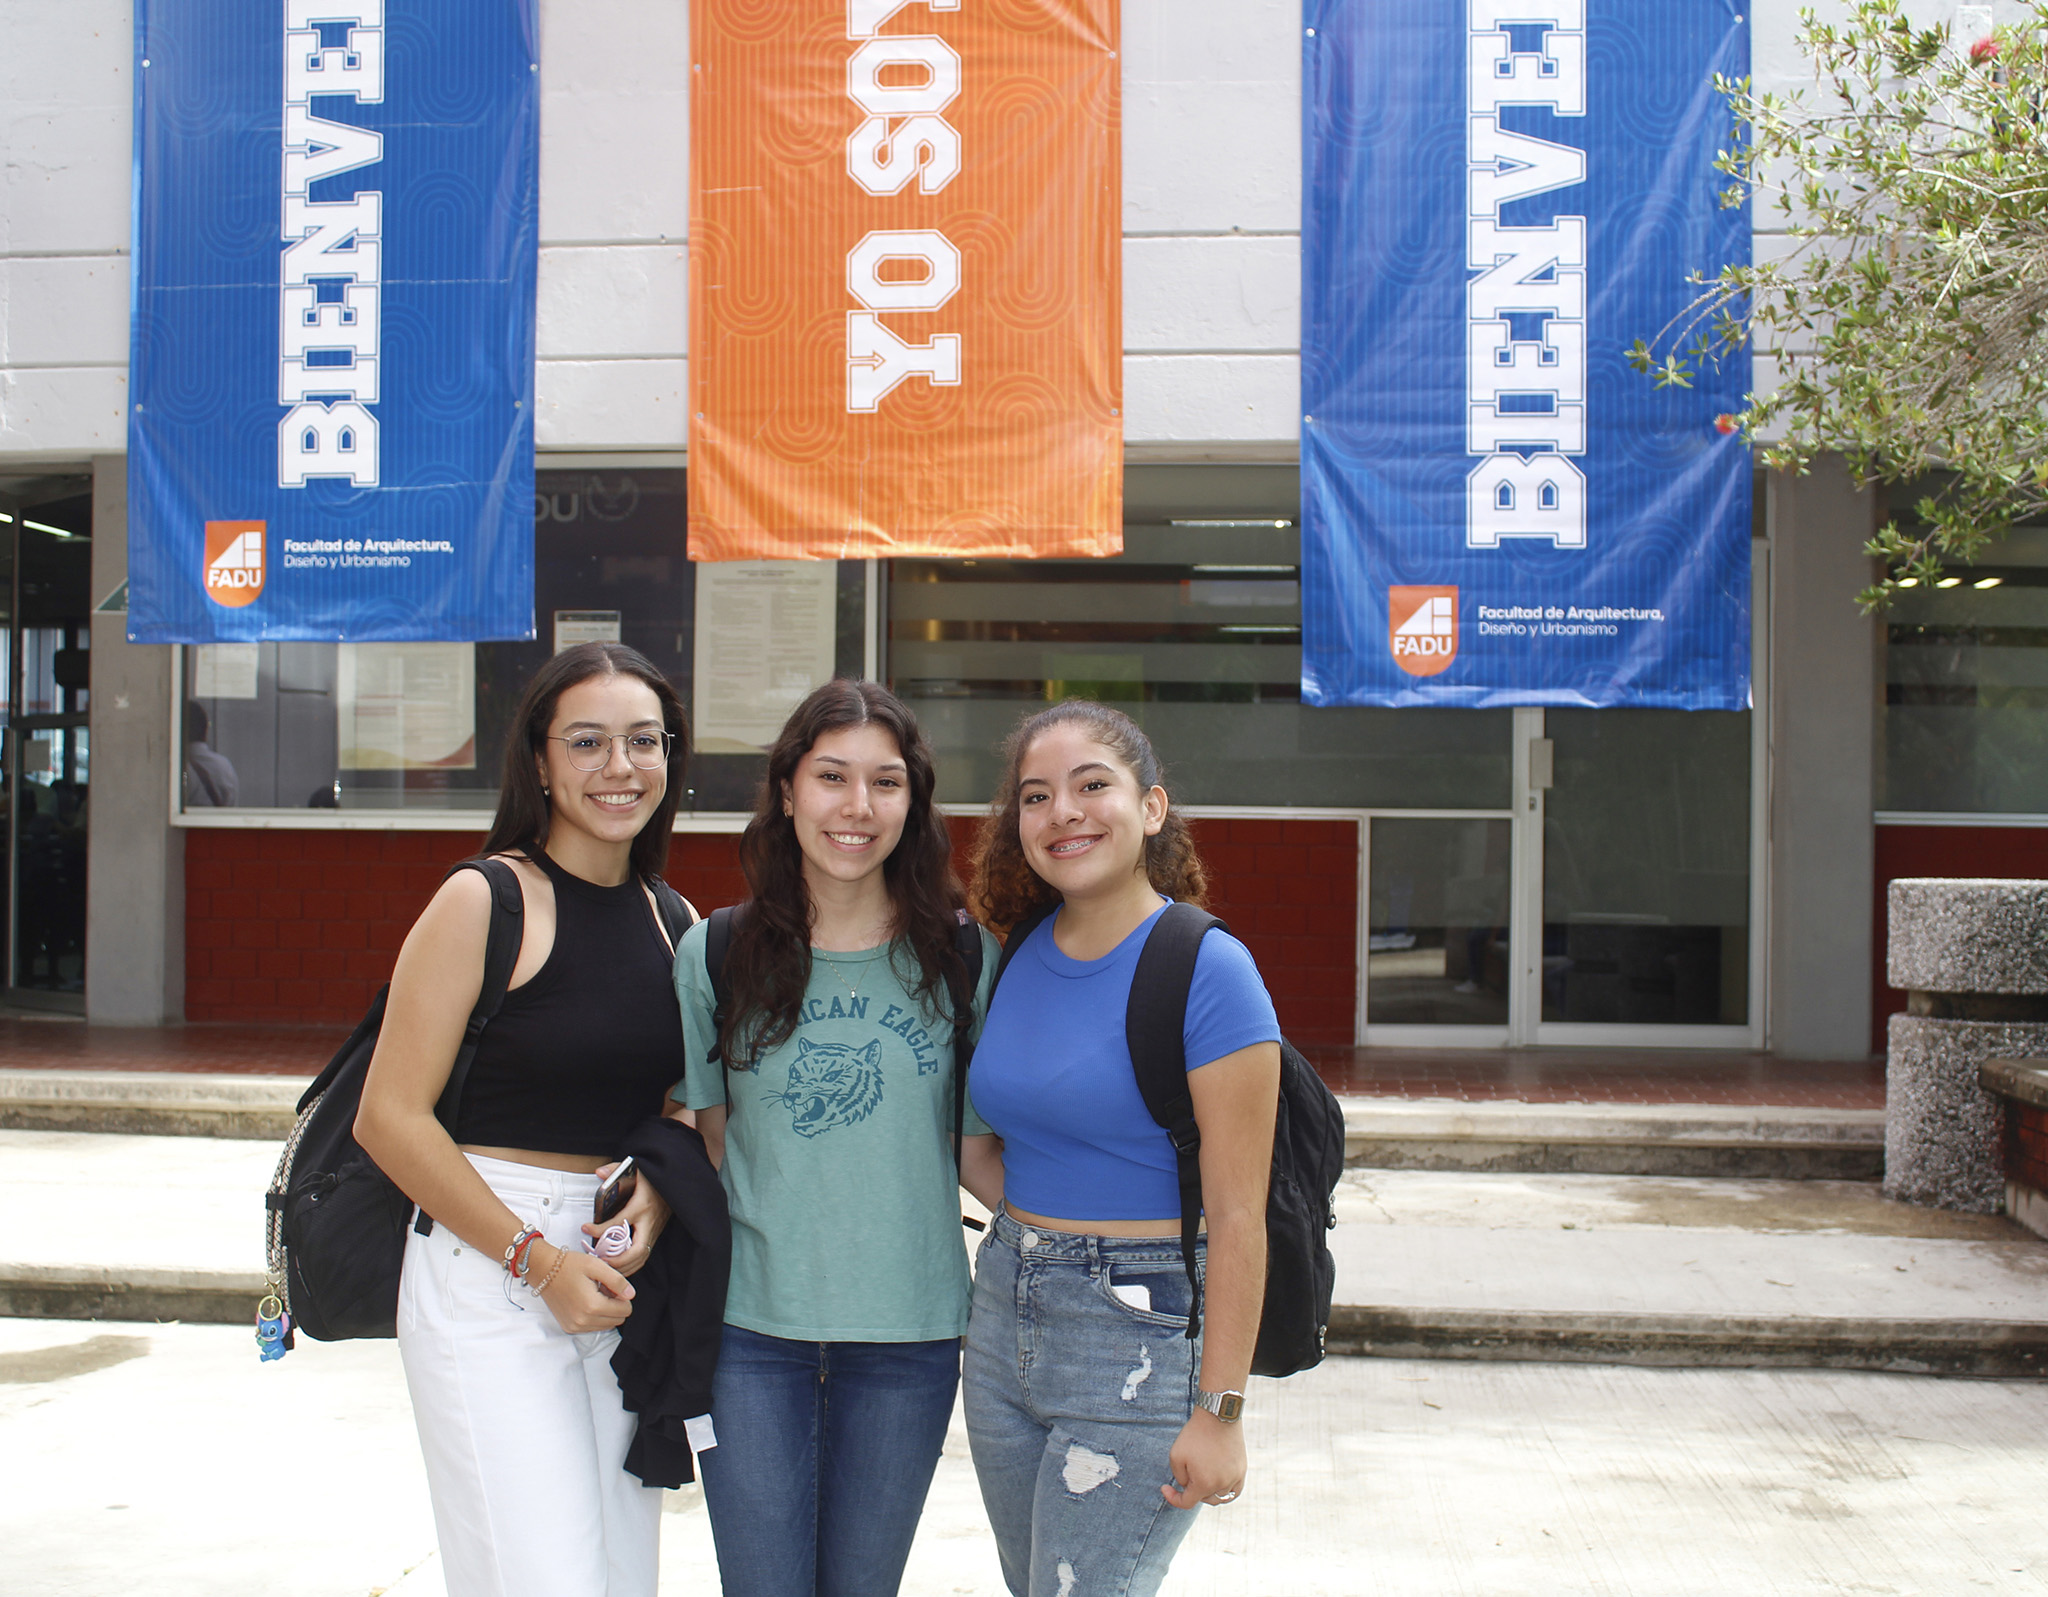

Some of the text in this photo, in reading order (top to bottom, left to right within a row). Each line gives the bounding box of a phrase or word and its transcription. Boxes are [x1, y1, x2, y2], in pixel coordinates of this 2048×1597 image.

[846, 229, 961, 413] YO
[284, 538, 455, 555] Facultad de Arquitectura,
[284, 554, 411, 571] Diseño y Urbanismo
[207, 569, 262, 588] FADU
[1478, 605, 1665, 622] Facultad de Arquitectura,
[1478, 621, 1618, 638] Diseño y Urbanismo
[1394, 636, 1453, 655] FADU
[878, 1003, 938, 1076] EAGLE
